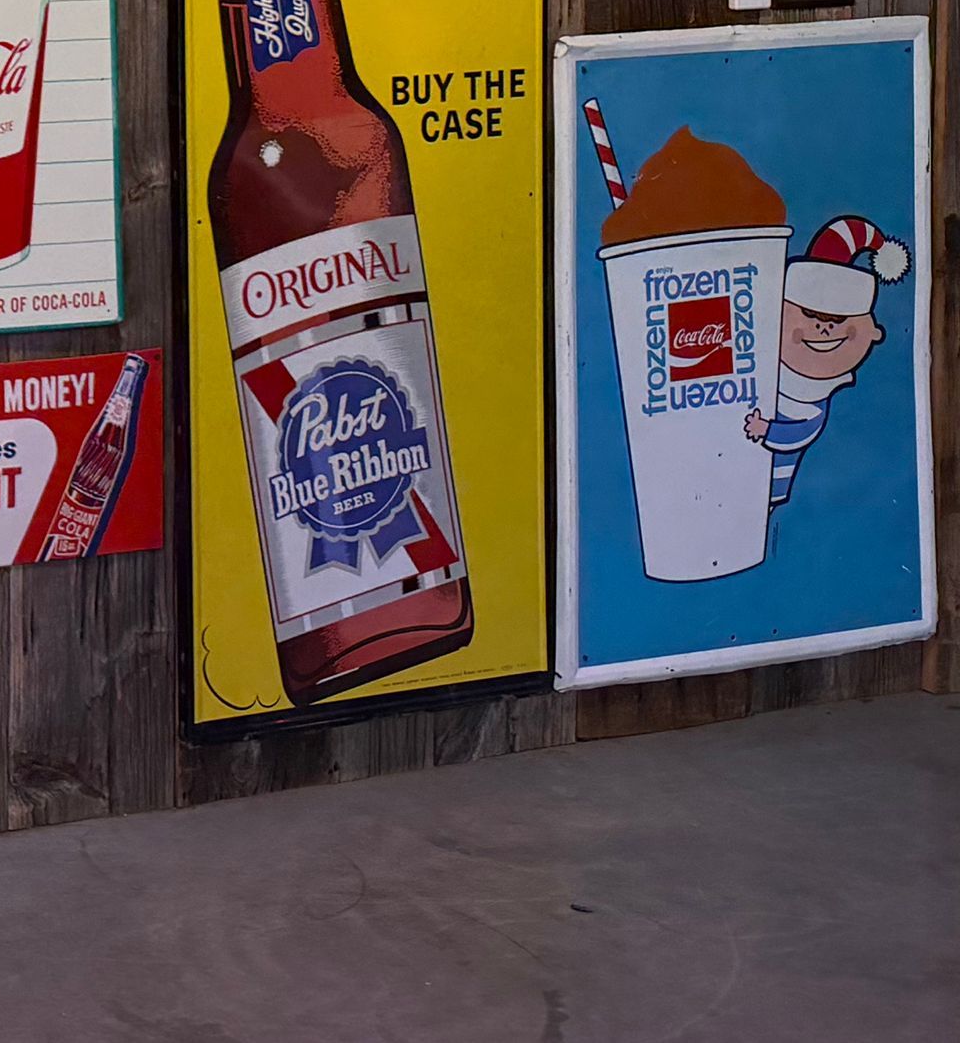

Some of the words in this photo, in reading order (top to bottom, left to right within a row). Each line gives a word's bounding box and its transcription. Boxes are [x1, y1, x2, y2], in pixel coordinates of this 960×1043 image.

[391, 73, 454, 106] BUY
[463, 69, 525, 99] THE
[420, 108, 503, 142] CASE
[242, 240, 411, 319] ORIGINAL
[643, 268, 730, 302] frozen
[656, 266, 673, 275] enjoy
[10, 297, 27, 313] OF
[32, 291, 107, 311] COCA-COLA
[733, 263, 759, 375] frozen
[673, 323, 726, 349] Coca-Cola
[642, 304, 668, 417] frozen
[3, 372, 96, 413] MONEY!
[670, 377, 759, 411] frozen
[289, 387, 388, 458] Pabst
[272, 470, 331, 519] Blue
[327, 440, 428, 496] Ribbon
[333, 490, 376, 516] BEER
[58, 518, 90, 539] COLA
